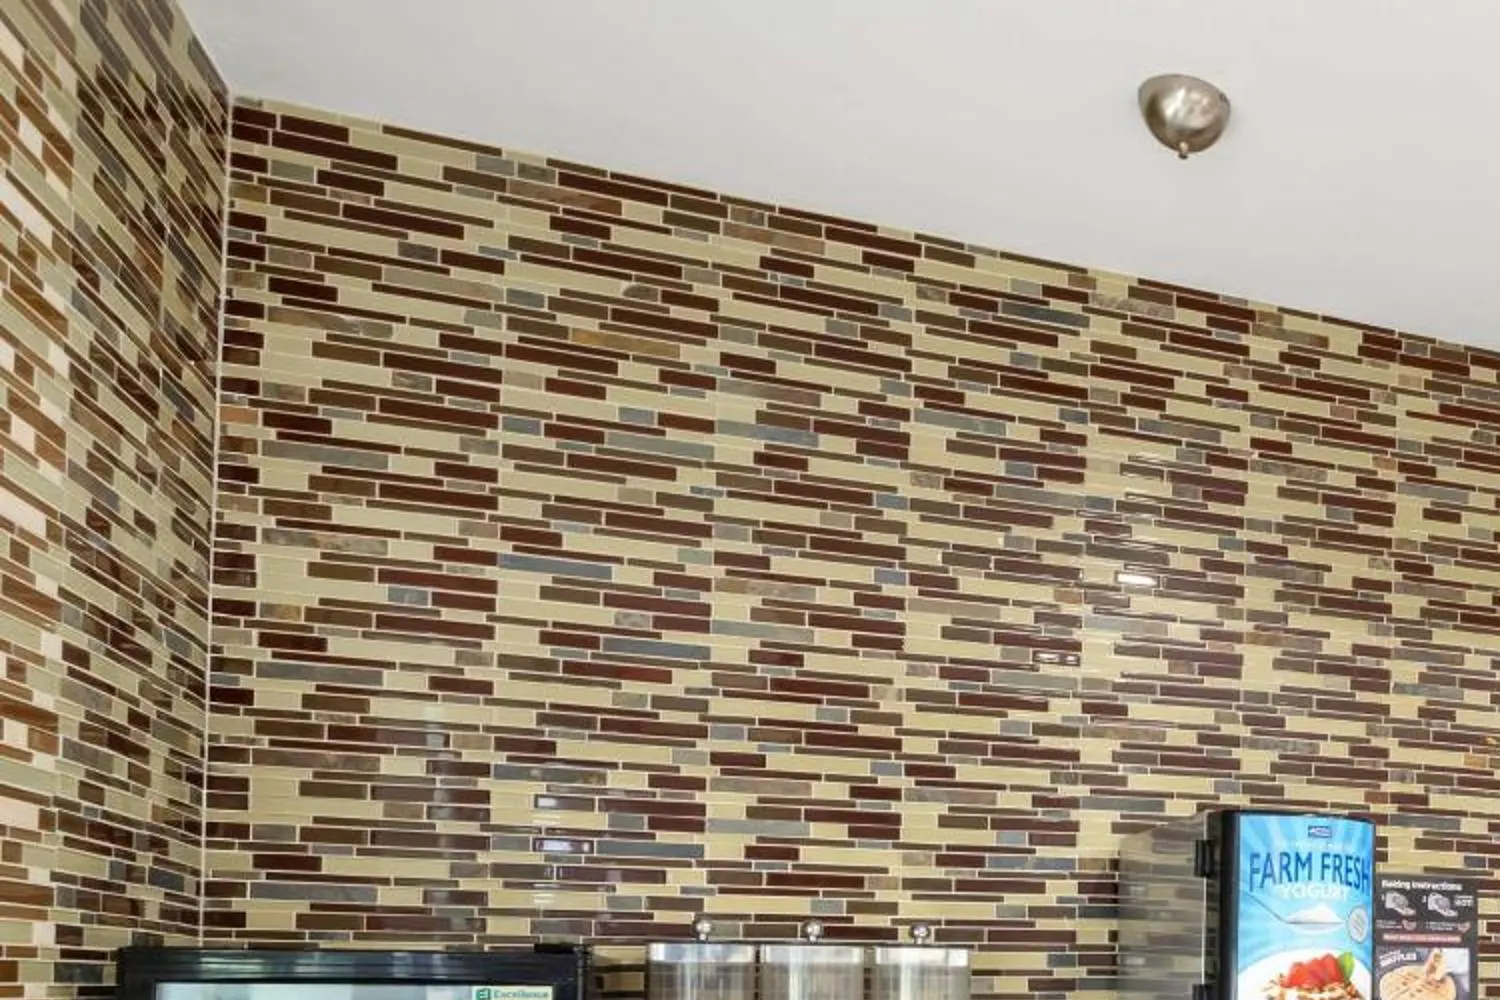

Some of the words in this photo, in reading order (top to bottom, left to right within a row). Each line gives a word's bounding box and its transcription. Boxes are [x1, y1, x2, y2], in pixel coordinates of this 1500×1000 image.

[1249, 851, 1312, 892] FARM
[1321, 852, 1371, 897] FRESH
[1280, 884, 1350, 901] YOGURT
[1412, 881, 1463, 891] Instructions
